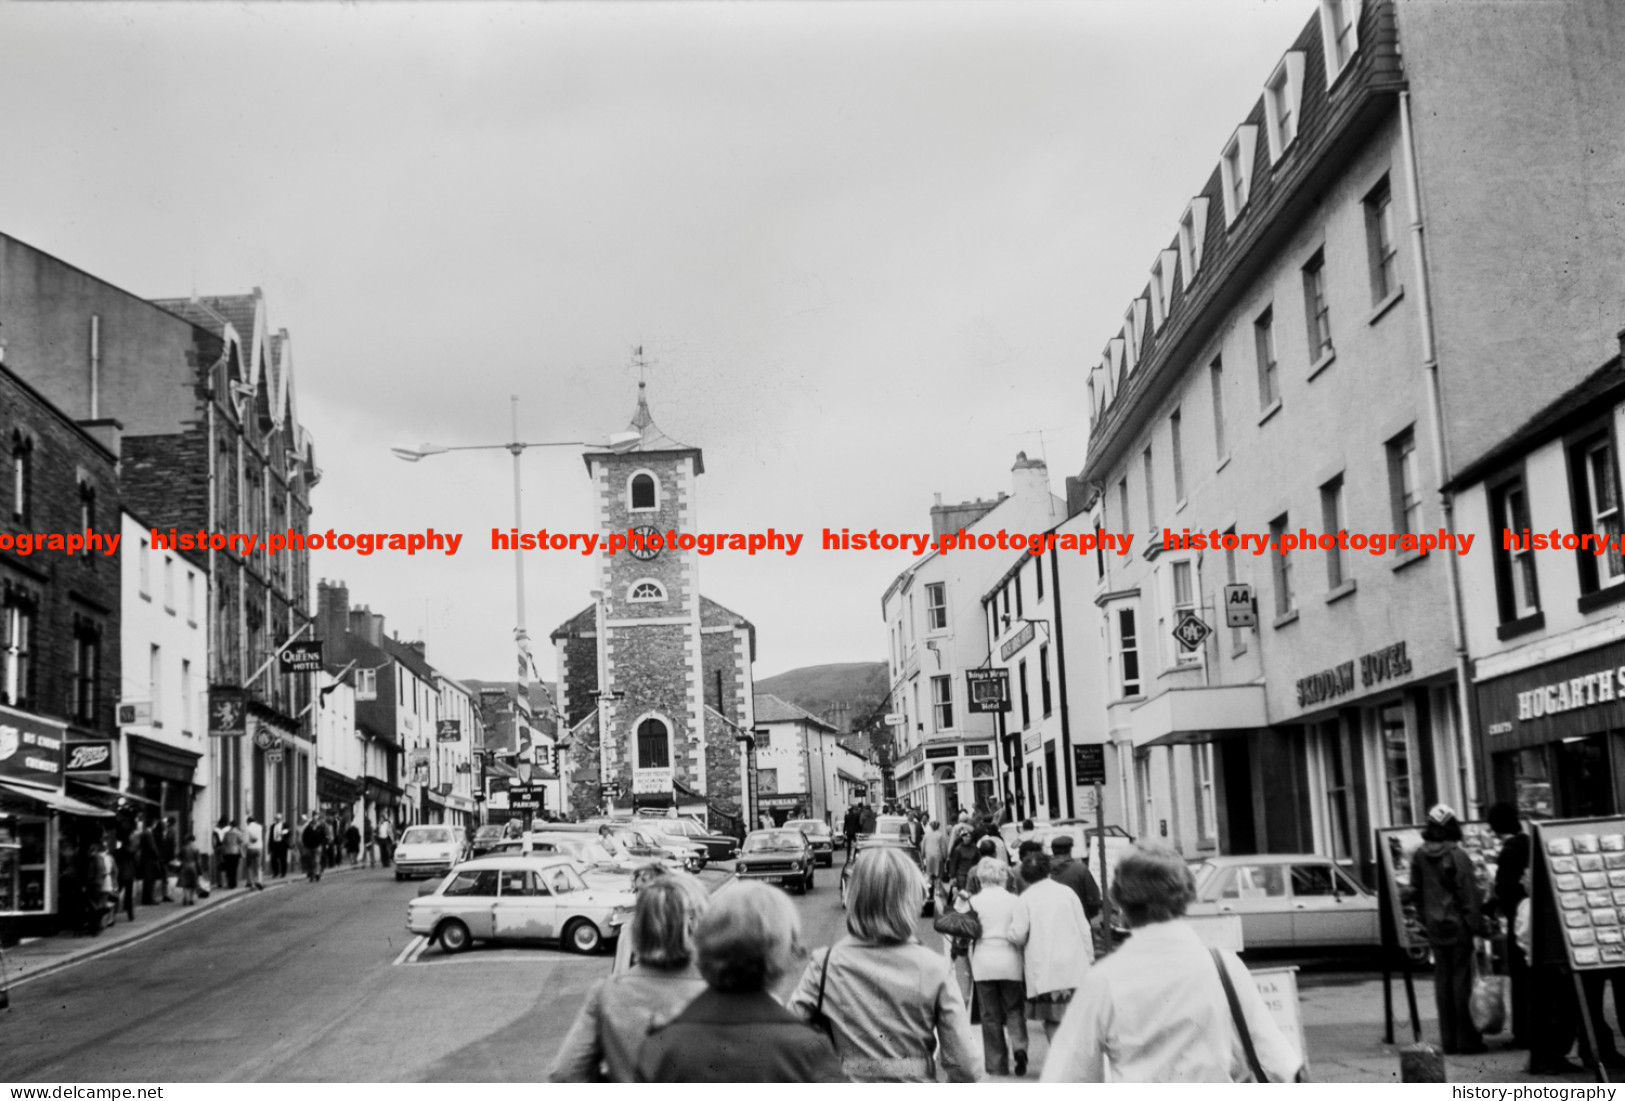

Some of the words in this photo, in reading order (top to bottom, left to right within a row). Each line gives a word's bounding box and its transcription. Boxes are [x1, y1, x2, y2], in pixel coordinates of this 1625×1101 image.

[1229, 590, 1249, 604] AA
[1183, 622, 1203, 641] RAC
[293, 662, 321, 670] HOTEL
[1359, 640, 1412, 687] HOTEL
[512, 801, 540, 809] PARKING
